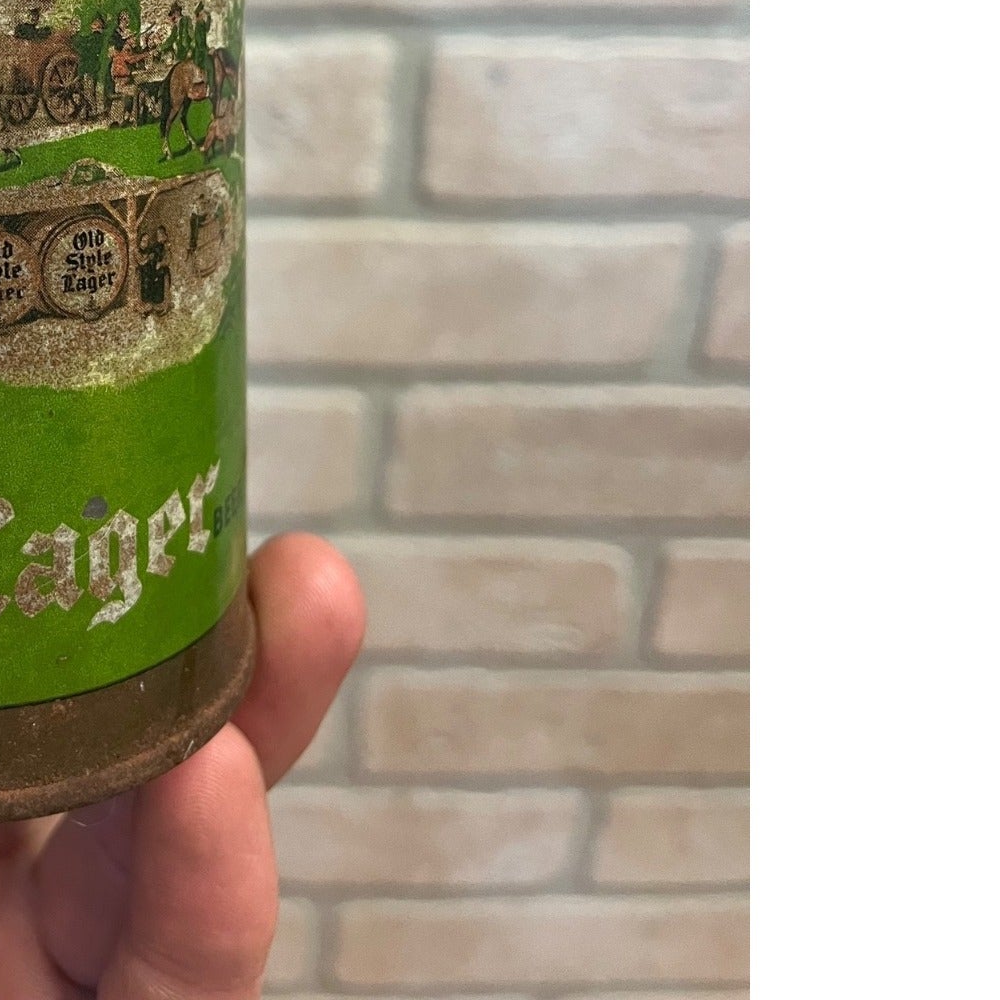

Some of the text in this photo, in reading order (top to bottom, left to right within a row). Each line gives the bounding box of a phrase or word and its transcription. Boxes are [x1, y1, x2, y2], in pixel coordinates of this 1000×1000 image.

[72, 229, 105, 251] Old
[65, 250, 113, 273] Style
[62, 270, 116, 294] Lager
